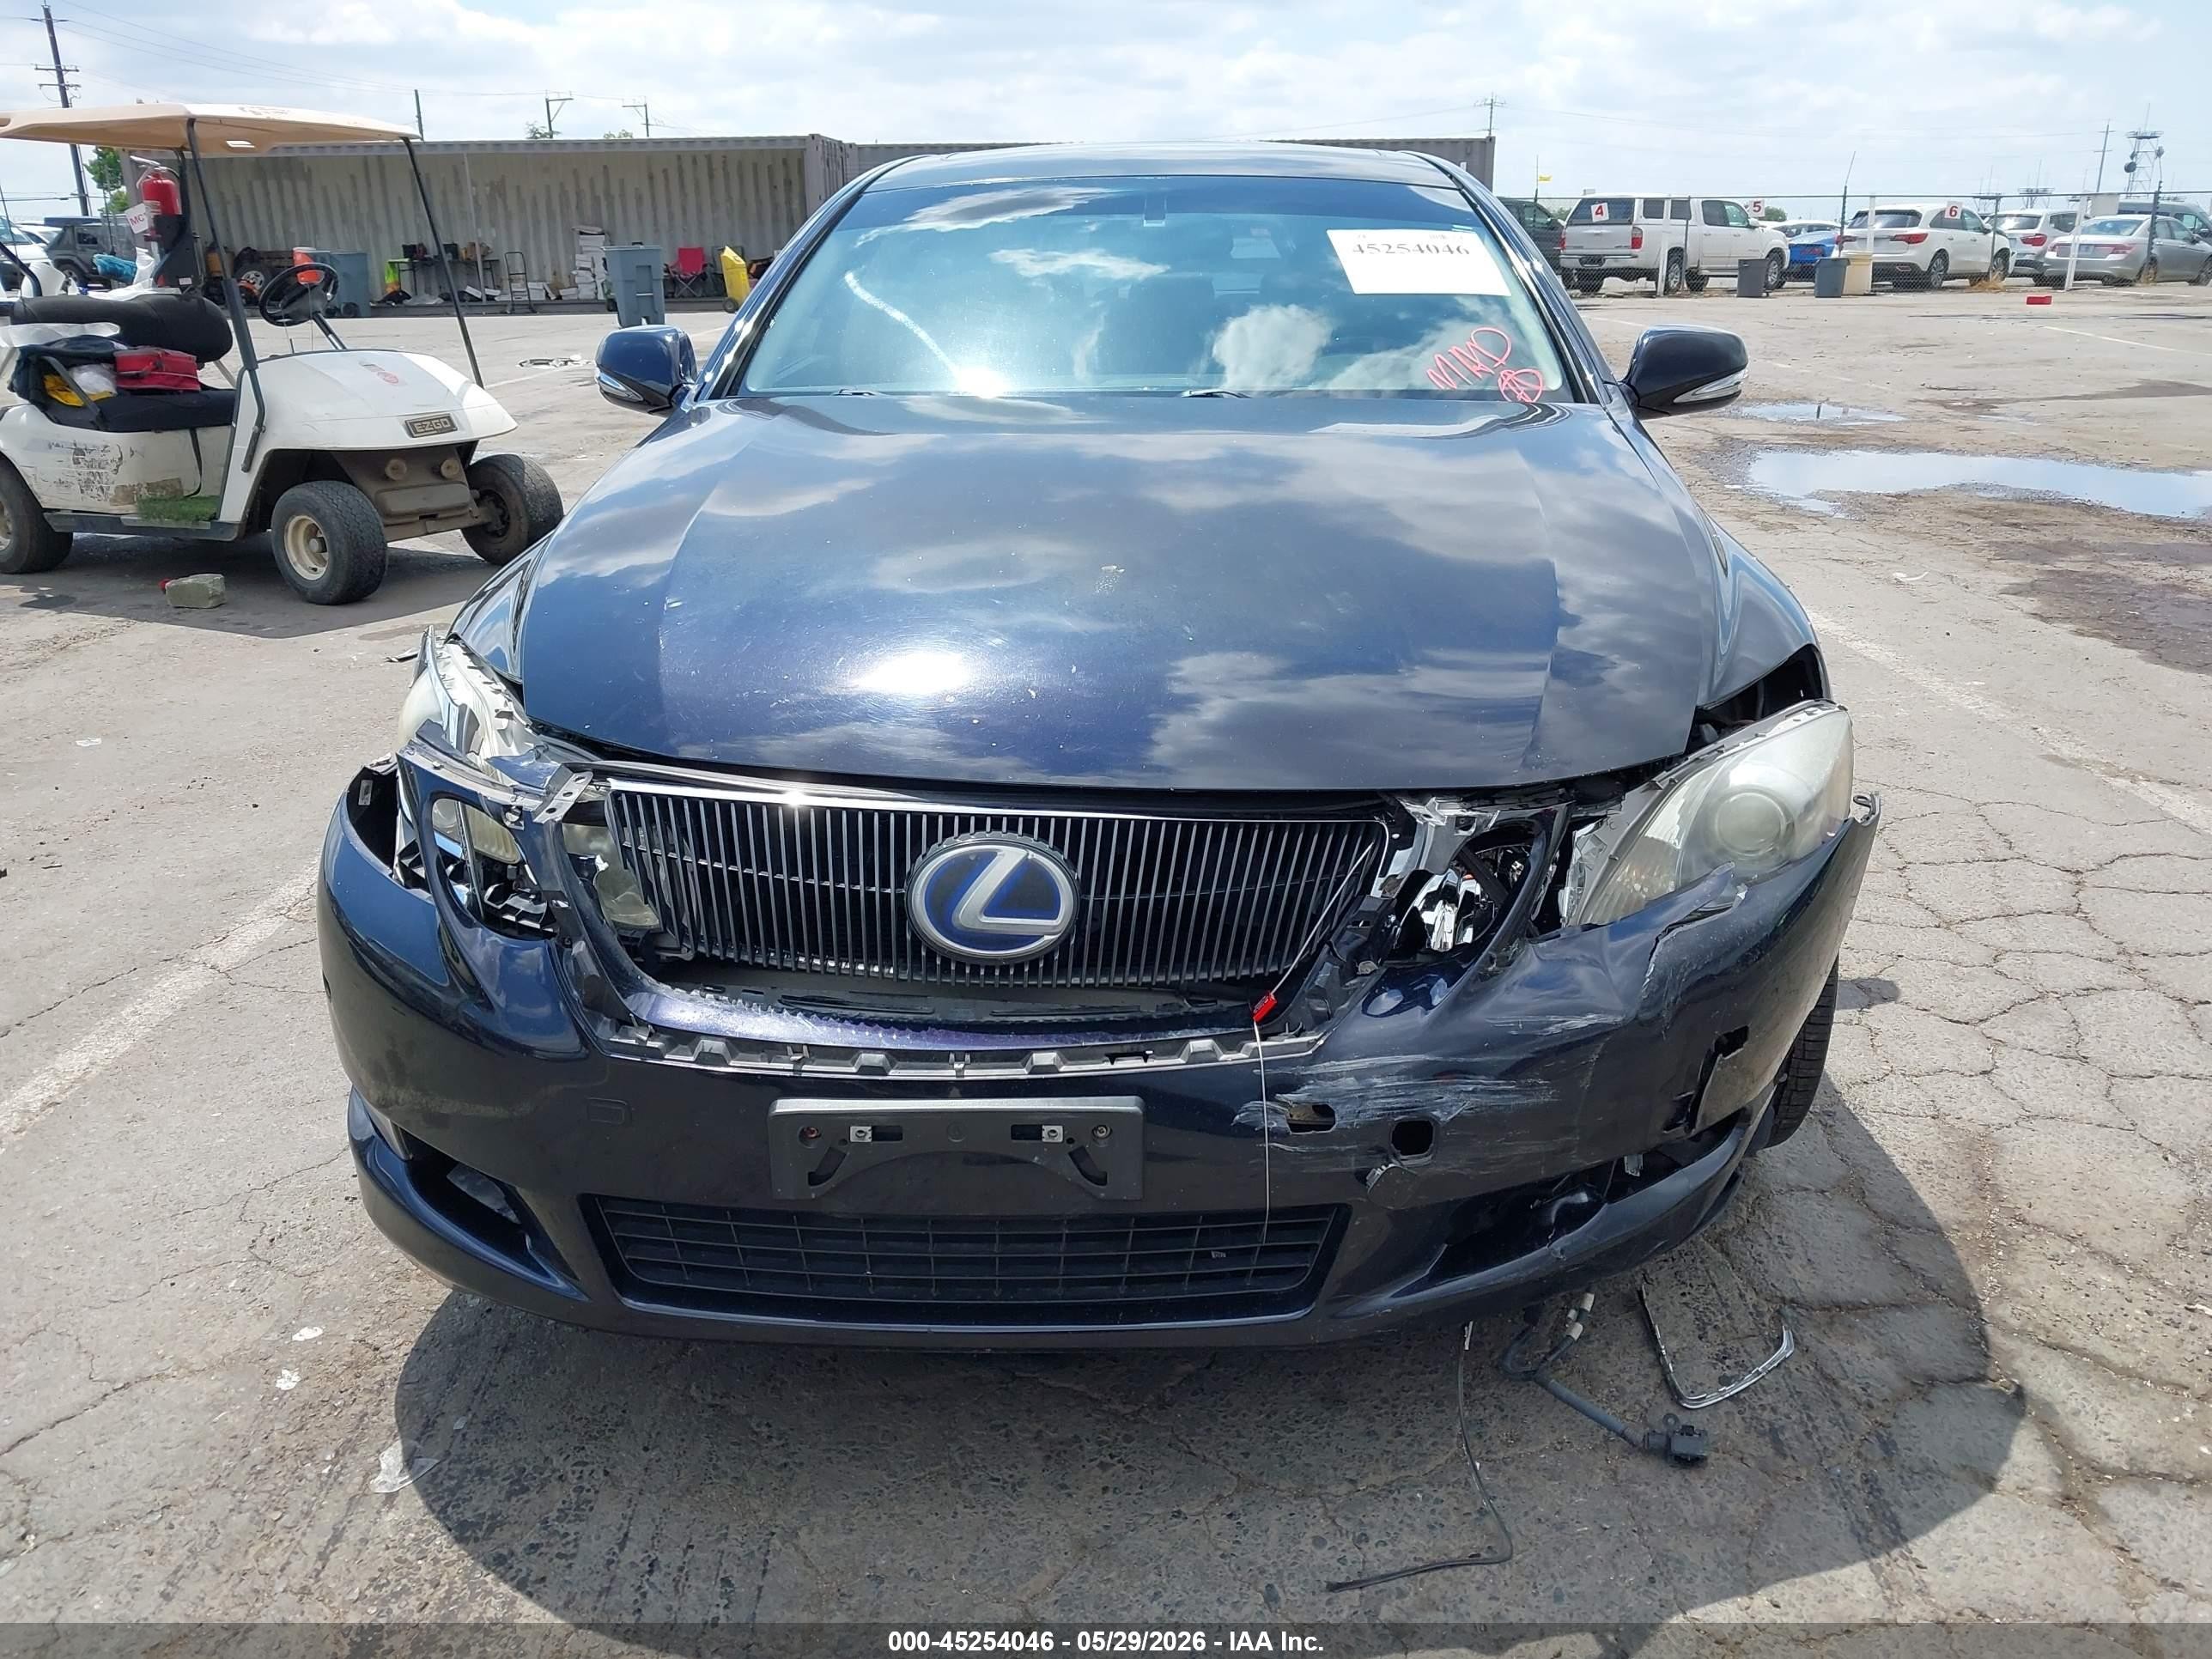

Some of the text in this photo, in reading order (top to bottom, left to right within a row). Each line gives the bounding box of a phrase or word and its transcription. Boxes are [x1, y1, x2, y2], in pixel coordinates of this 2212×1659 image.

[1595, 204, 1604, 217] 4
[1753, 201, 1762, 213] 5
[1948, 205, 1959, 217] 6
[1352, 243, 1471, 256] 45254046
